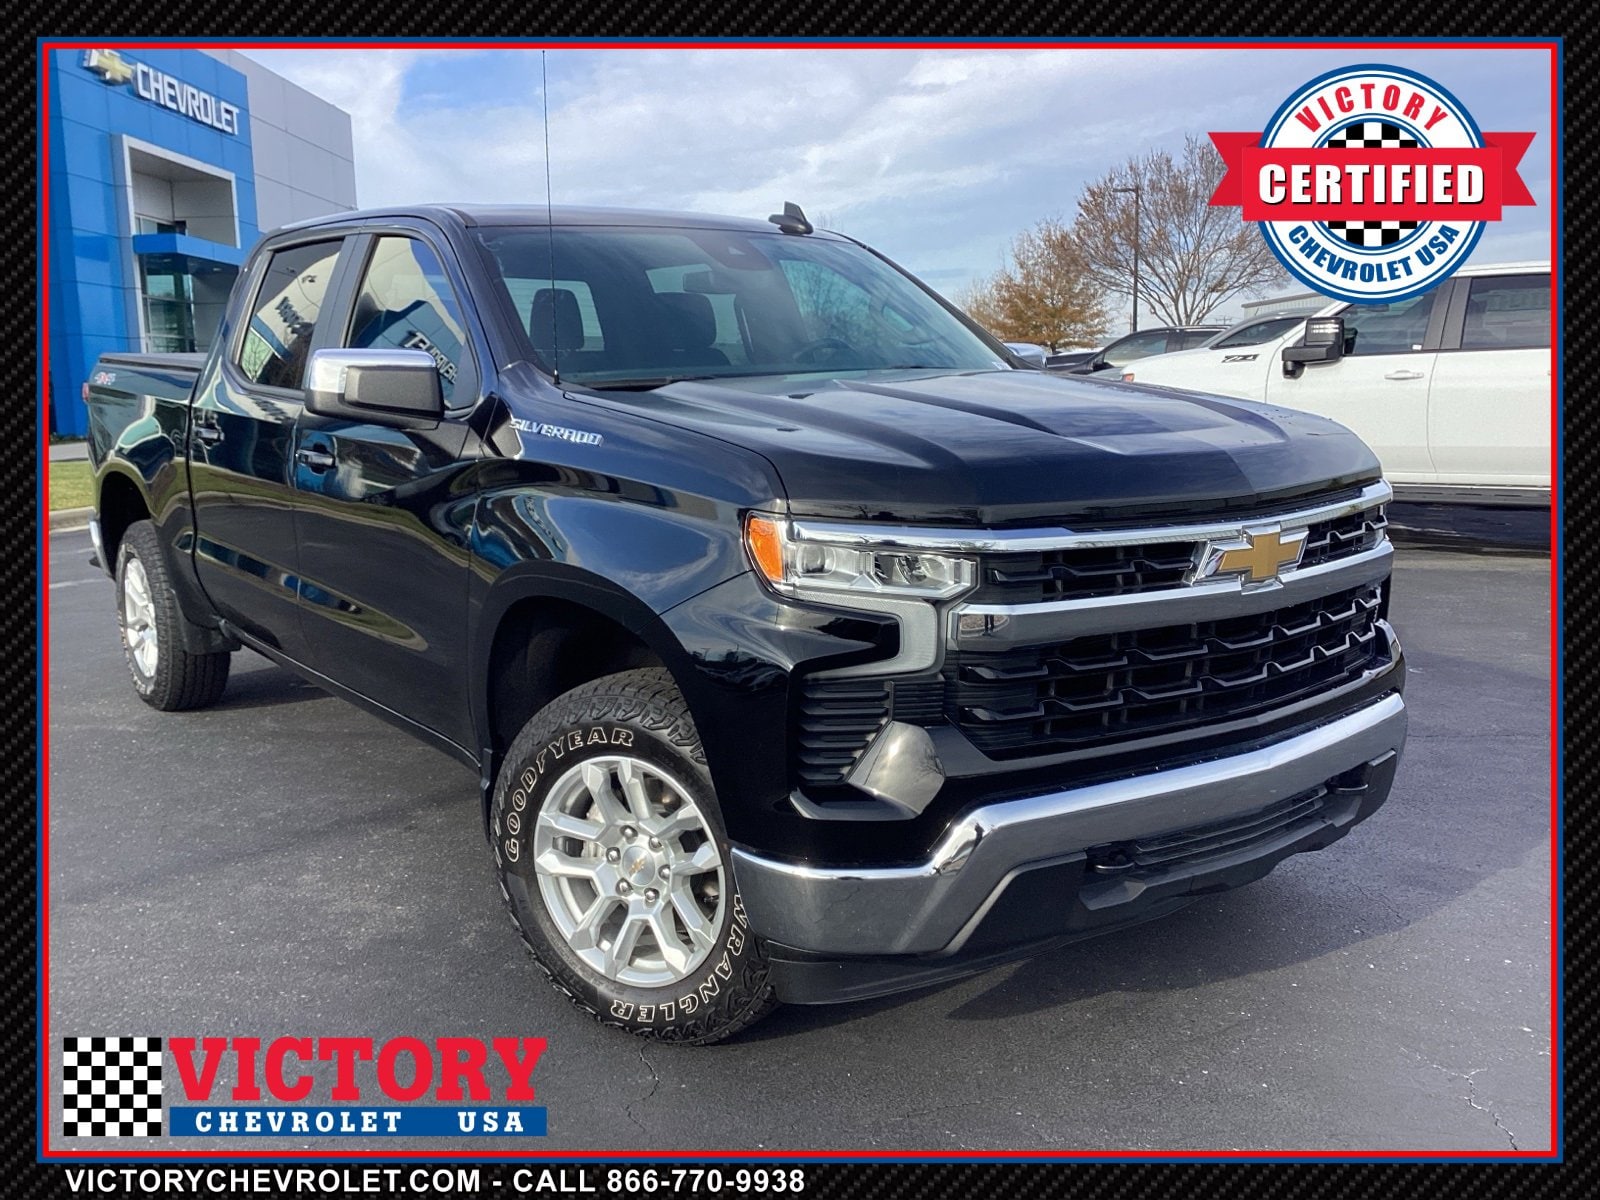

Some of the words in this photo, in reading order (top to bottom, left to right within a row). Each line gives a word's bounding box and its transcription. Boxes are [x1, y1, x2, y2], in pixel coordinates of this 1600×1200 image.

[136, 62, 240, 136] CHEVROLET
[509, 418, 603, 446] SILVERADO
[504, 726, 634, 863] GOODYEAR
[610, 894, 748, 1023] WRANGLER
